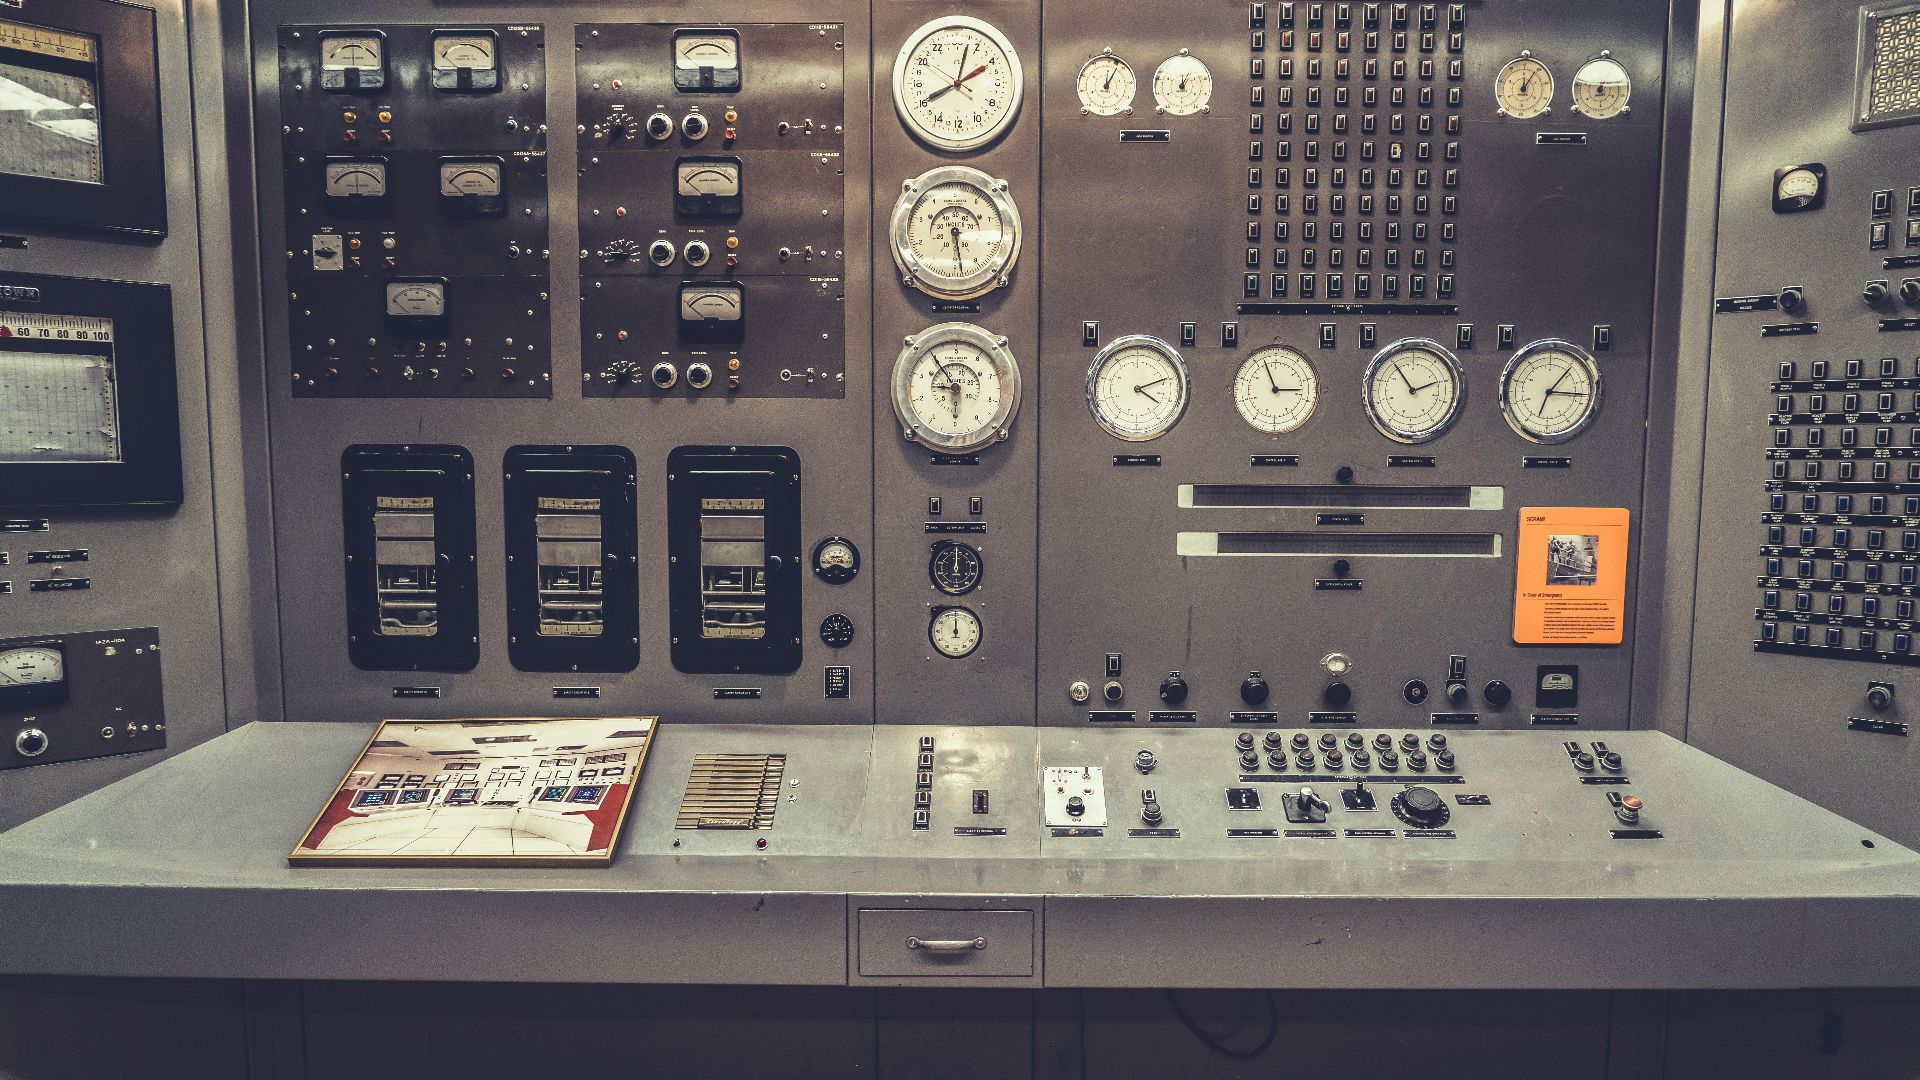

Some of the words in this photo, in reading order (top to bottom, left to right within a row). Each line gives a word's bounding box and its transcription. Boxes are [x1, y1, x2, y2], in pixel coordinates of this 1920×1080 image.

[932, 43, 942, 52] 22
[974, 43, 980, 52] 2
[918, 57, 928, 66] 20
[988, 57, 996, 65] 4
[919, 99, 928, 108] 16
[988, 99, 996, 107] 8
[934, 115, 943, 123] 14
[973, 115, 982, 123] 10
[954, 120, 963, 128] 12
[17, 326, 30, 337] 60
[37, 328, 50, 338] 70
[57, 329, 69, 339] 80
[76, 330, 89, 340] 90
[93, 331, 110, 341] 100
